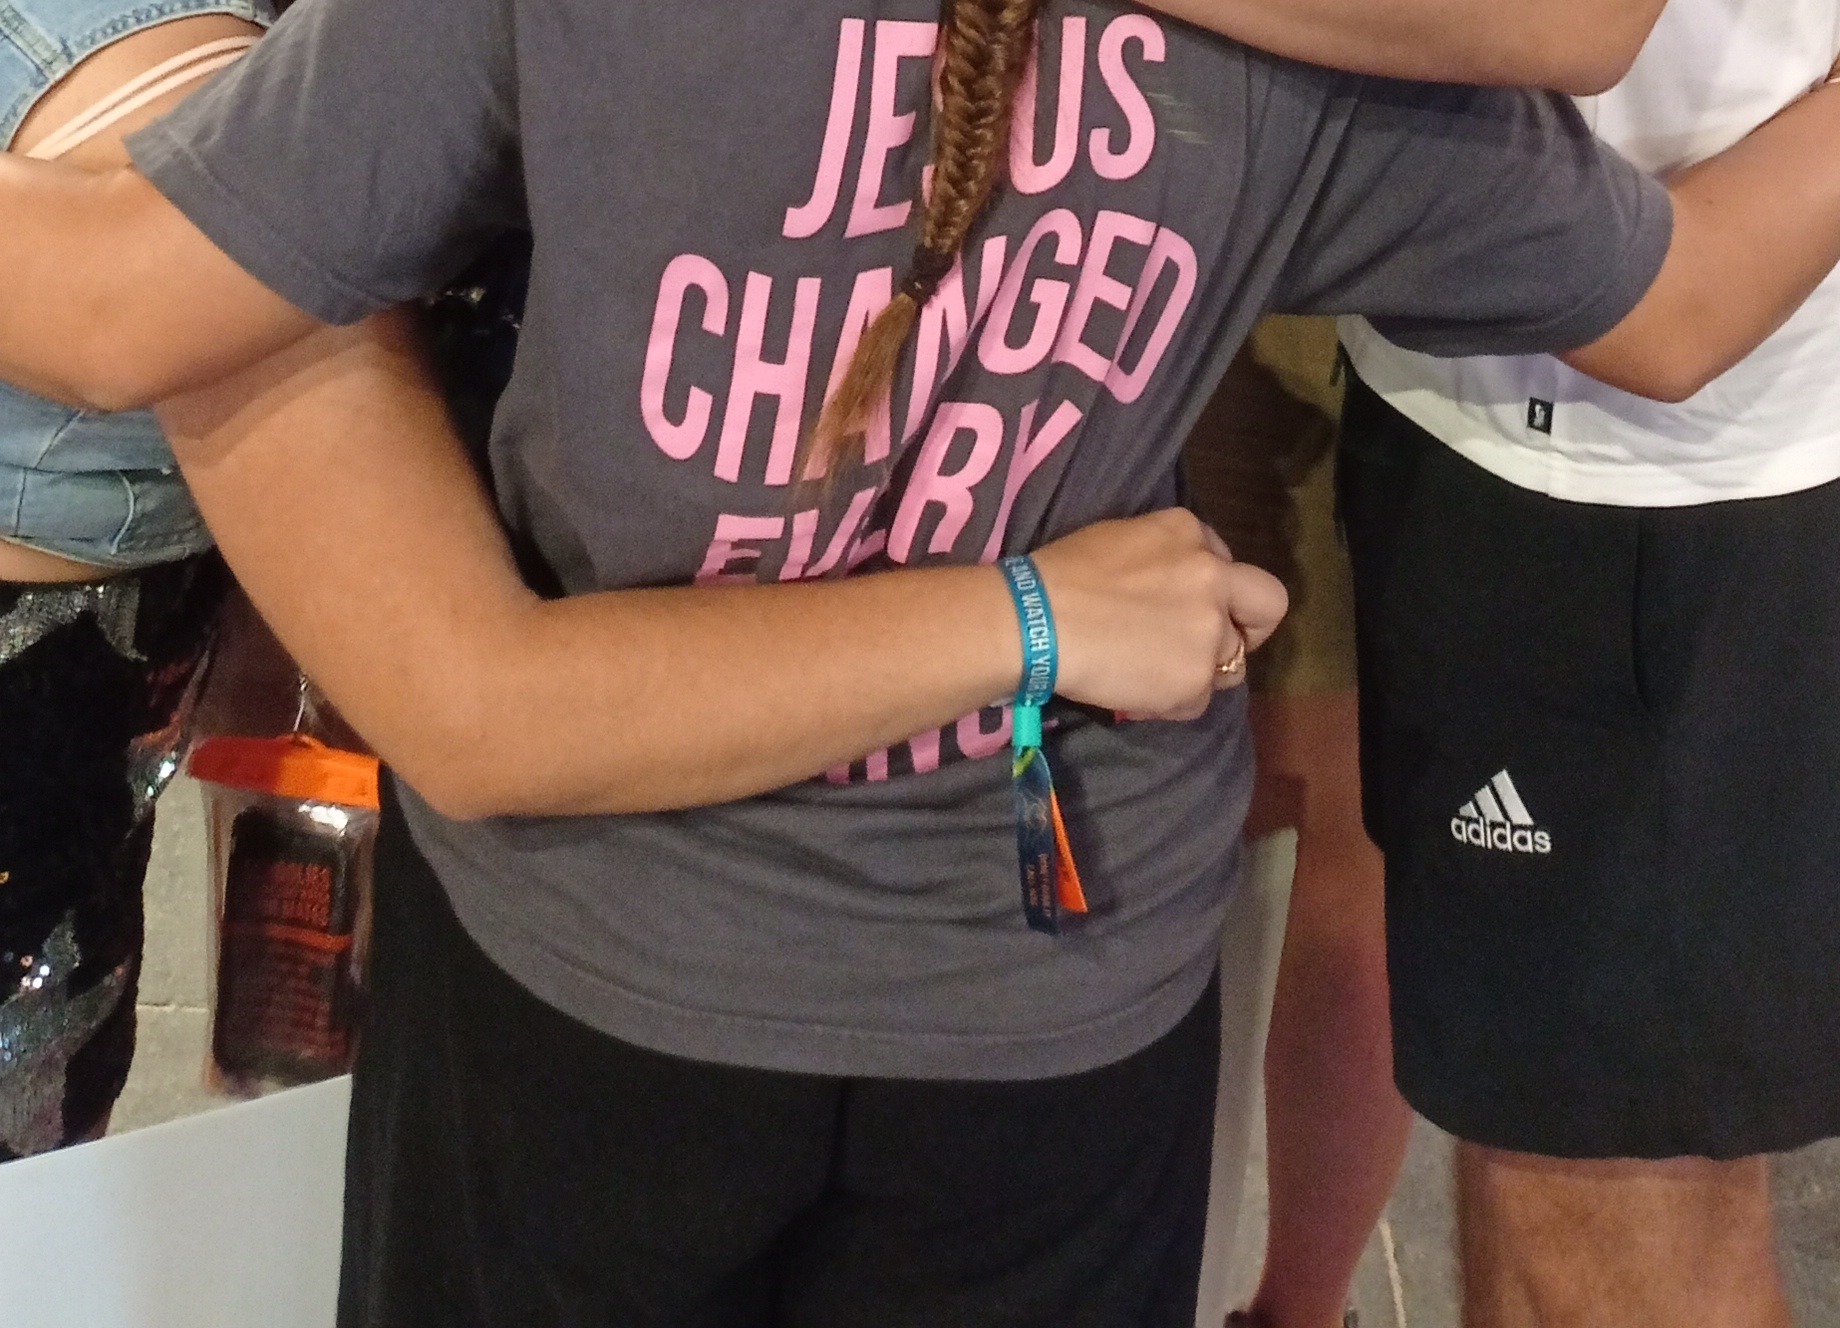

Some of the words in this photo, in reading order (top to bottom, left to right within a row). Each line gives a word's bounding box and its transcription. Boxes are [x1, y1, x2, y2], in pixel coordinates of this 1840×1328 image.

[781, 14, 1166, 239] JEUS
[694, 397, 1082, 584] EVRY
[1021, 591, 1050, 652] WATCH
[1451, 816, 1551, 853] adidas
